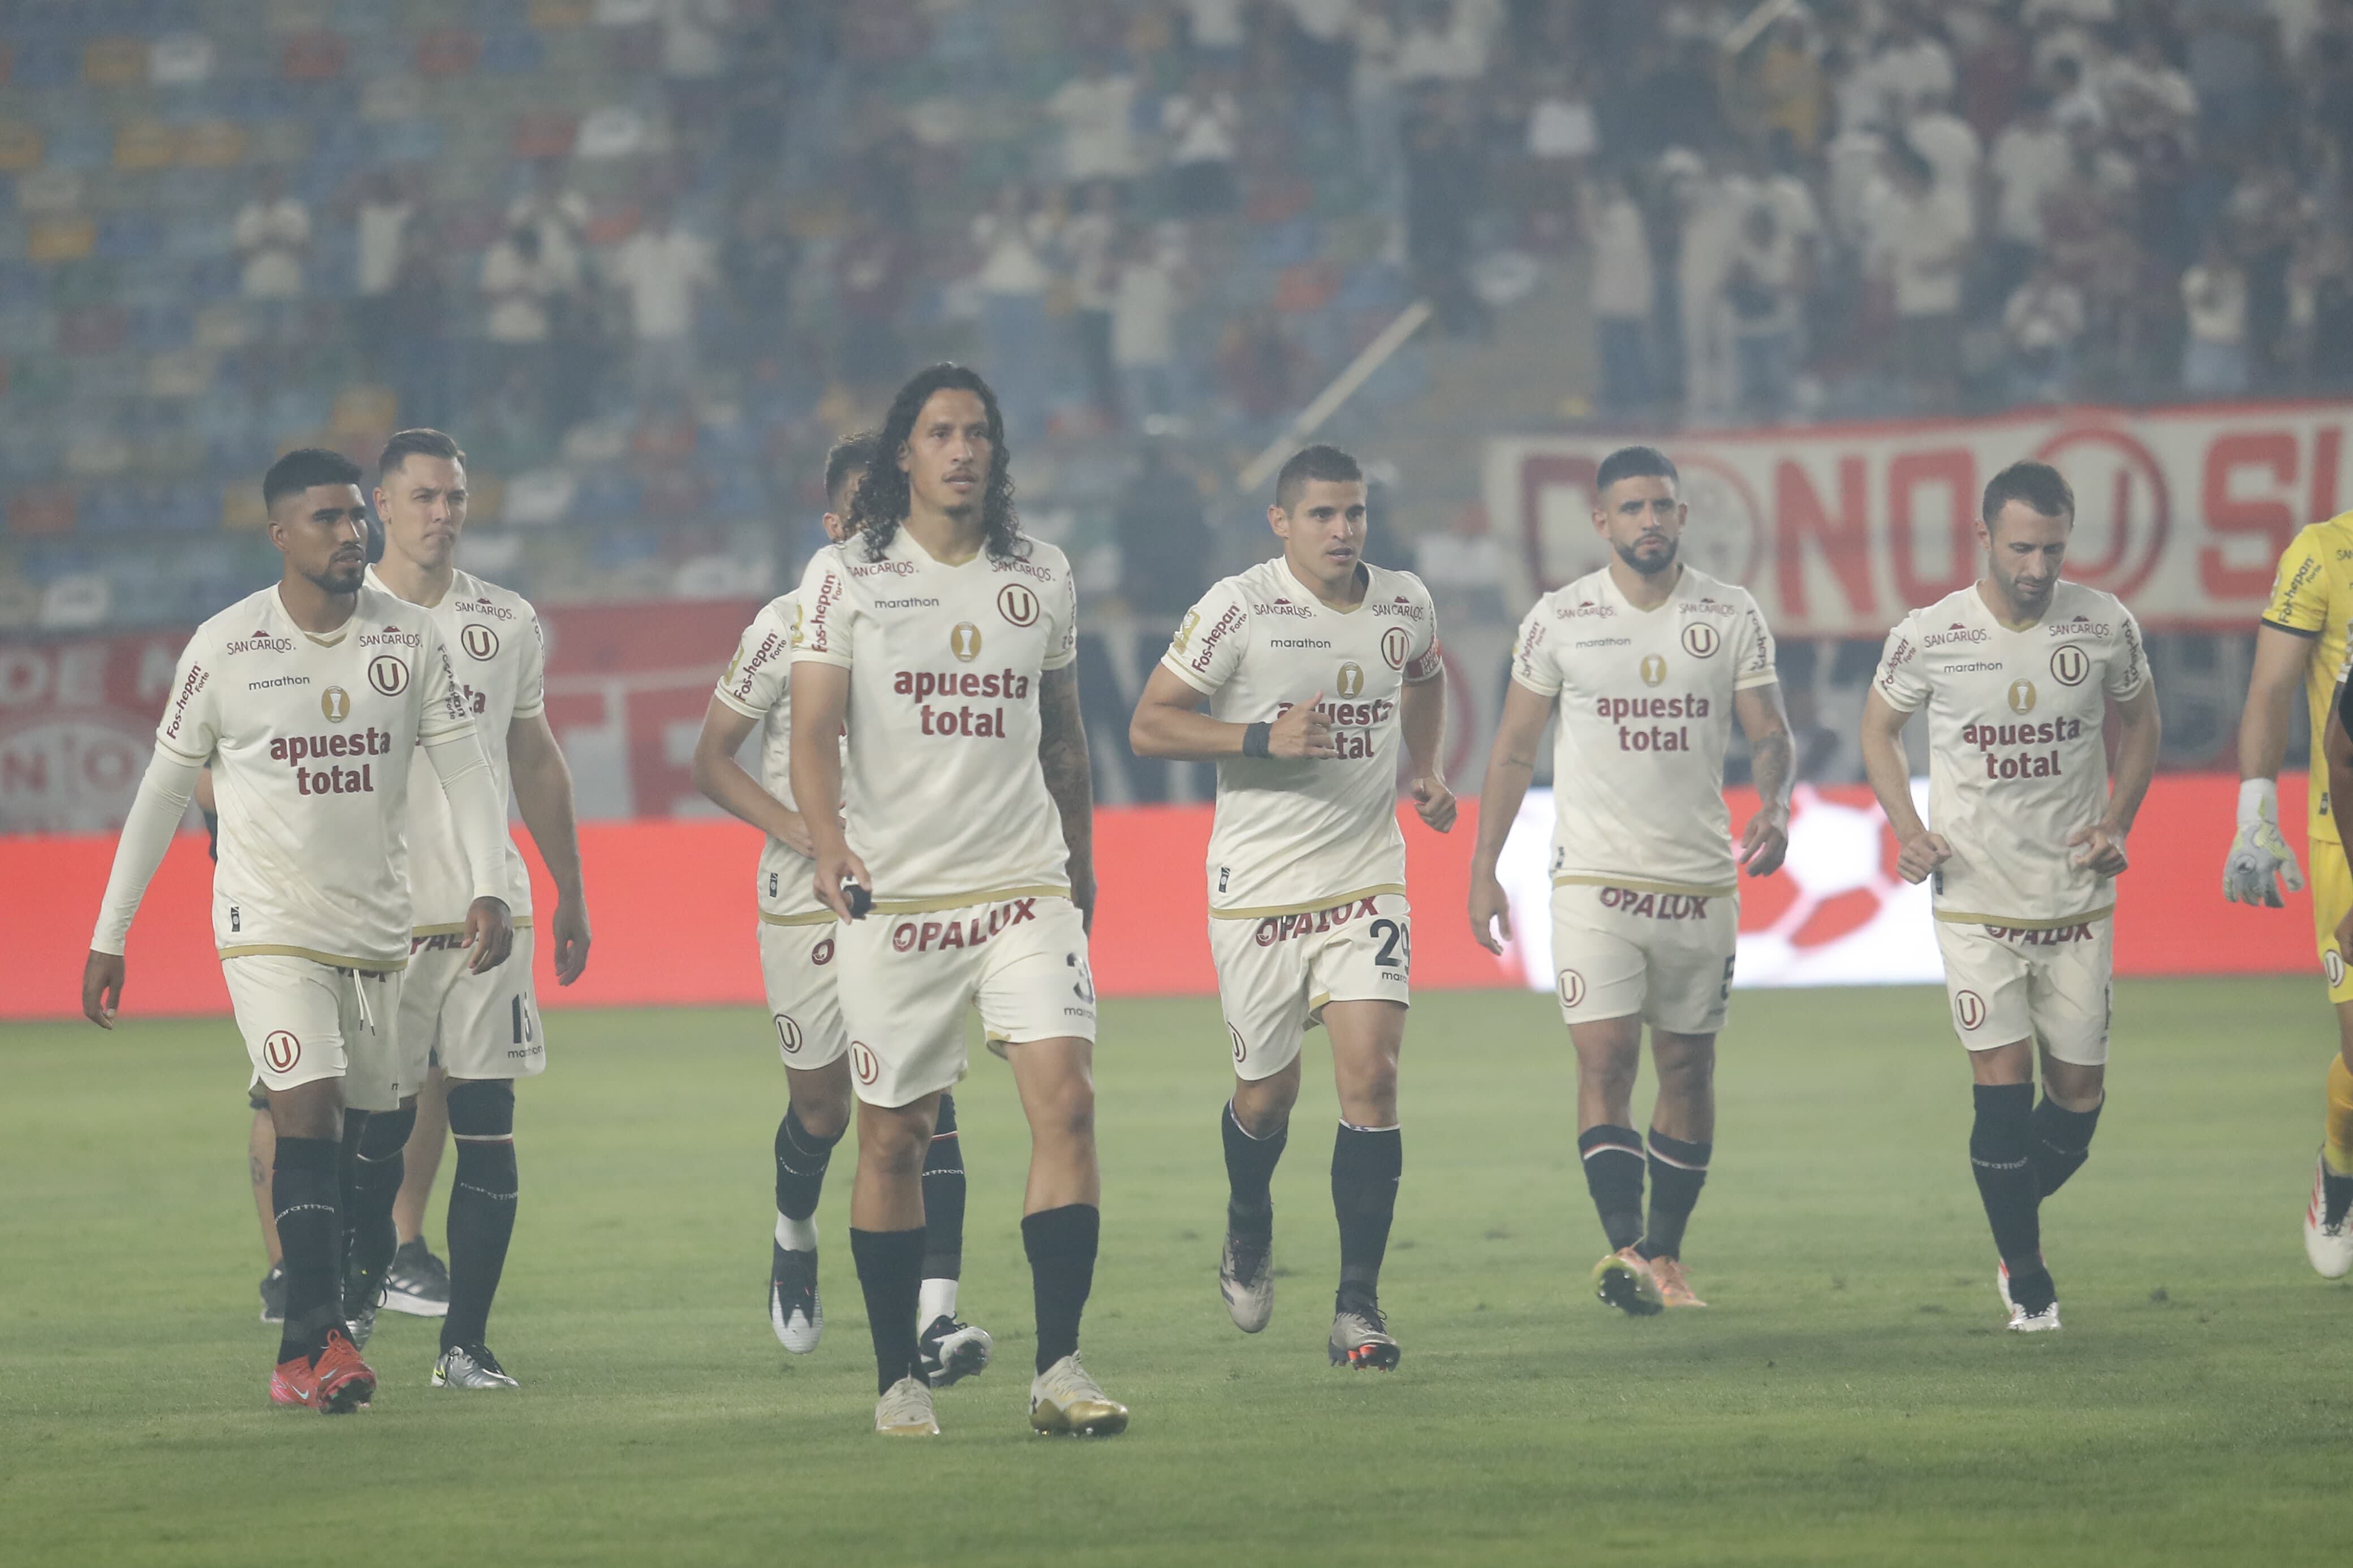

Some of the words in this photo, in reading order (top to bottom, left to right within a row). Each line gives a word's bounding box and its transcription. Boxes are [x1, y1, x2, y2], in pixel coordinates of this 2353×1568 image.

[455, 601, 474, 612] SAN
[874, 597, 940, 609] marathon
[1254, 604, 1274, 615] SAN
[1372, 604, 1391, 616] SAN
[359, 634, 381, 647] SAN
[1191, 604, 1240, 673] Fos-hepan
[1924, 634, 1945, 648] SAN
[2049, 625, 2070, 637] SAN
[227, 641, 248, 655] SAN
[769, 640, 787, 660] Forte
[1270, 638, 1331, 649] marathon
[1575, 637, 1631, 649] marathon
[733, 632, 778, 702] Fos-hepan
[1944, 662, 2003, 673] marathon
[195, 671, 210, 693] Forte
[249, 676, 311, 690] marathon
[893, 668, 1029, 704] apuesta
[166, 663, 201, 740] Fos-hepan
[1597, 693, 1710, 724] apuesta
[920, 705, 1006, 739] total
[1619, 726, 1690, 751] total
[1962, 716, 2080, 752] apuesta
[270, 727, 391, 767] apuesta
[1986, 750, 2062, 780] total
[297, 763, 374, 796] total
[1600, 887, 1709, 920] OPALUX
[892, 897, 1037, 953] OPALUX
